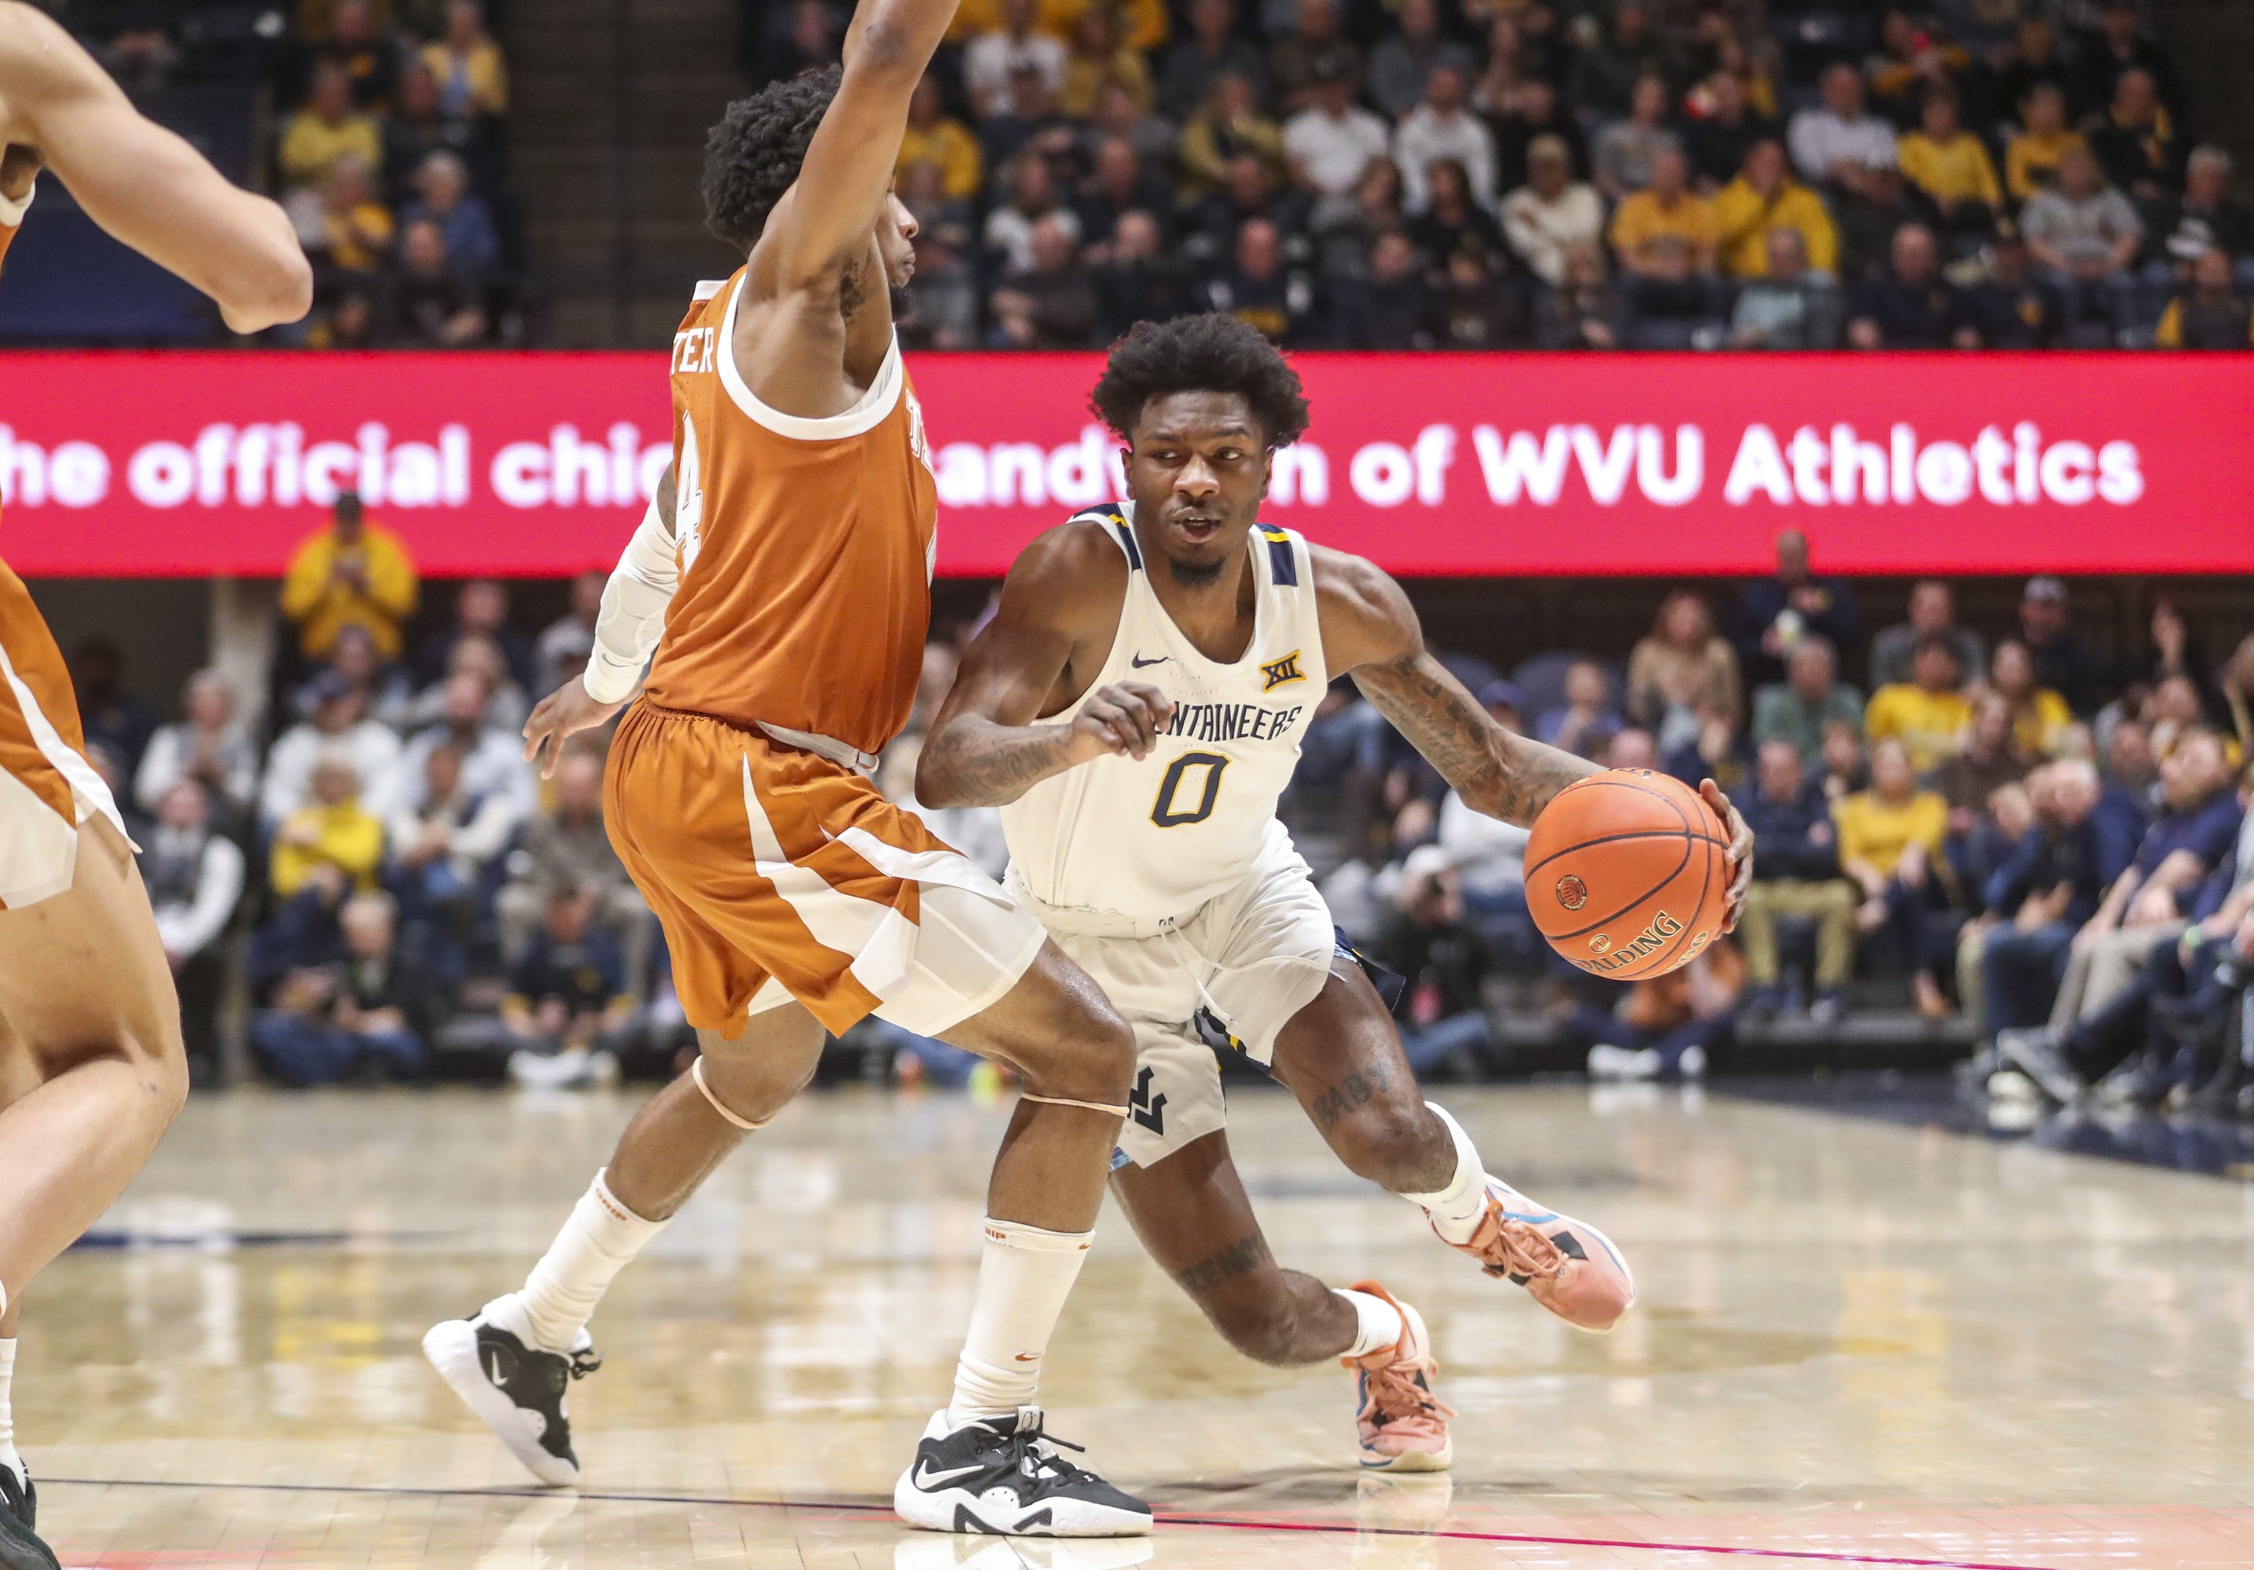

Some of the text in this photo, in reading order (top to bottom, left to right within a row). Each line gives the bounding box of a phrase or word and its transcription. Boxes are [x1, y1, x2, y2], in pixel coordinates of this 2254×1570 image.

[669, 326, 714, 375] TER
[0, 422, 110, 507] he
[127, 422, 470, 507] official
[490, 422, 674, 507] chic
[1350, 423, 1457, 507] of
[1472, 423, 1704, 507] WVU
[1724, 421, 2144, 506] Athletics
[675, 409, 702, 577] 4
[1155, 701, 1302, 742] NTAINEERS
[1149, 750, 1232, 828] 0
